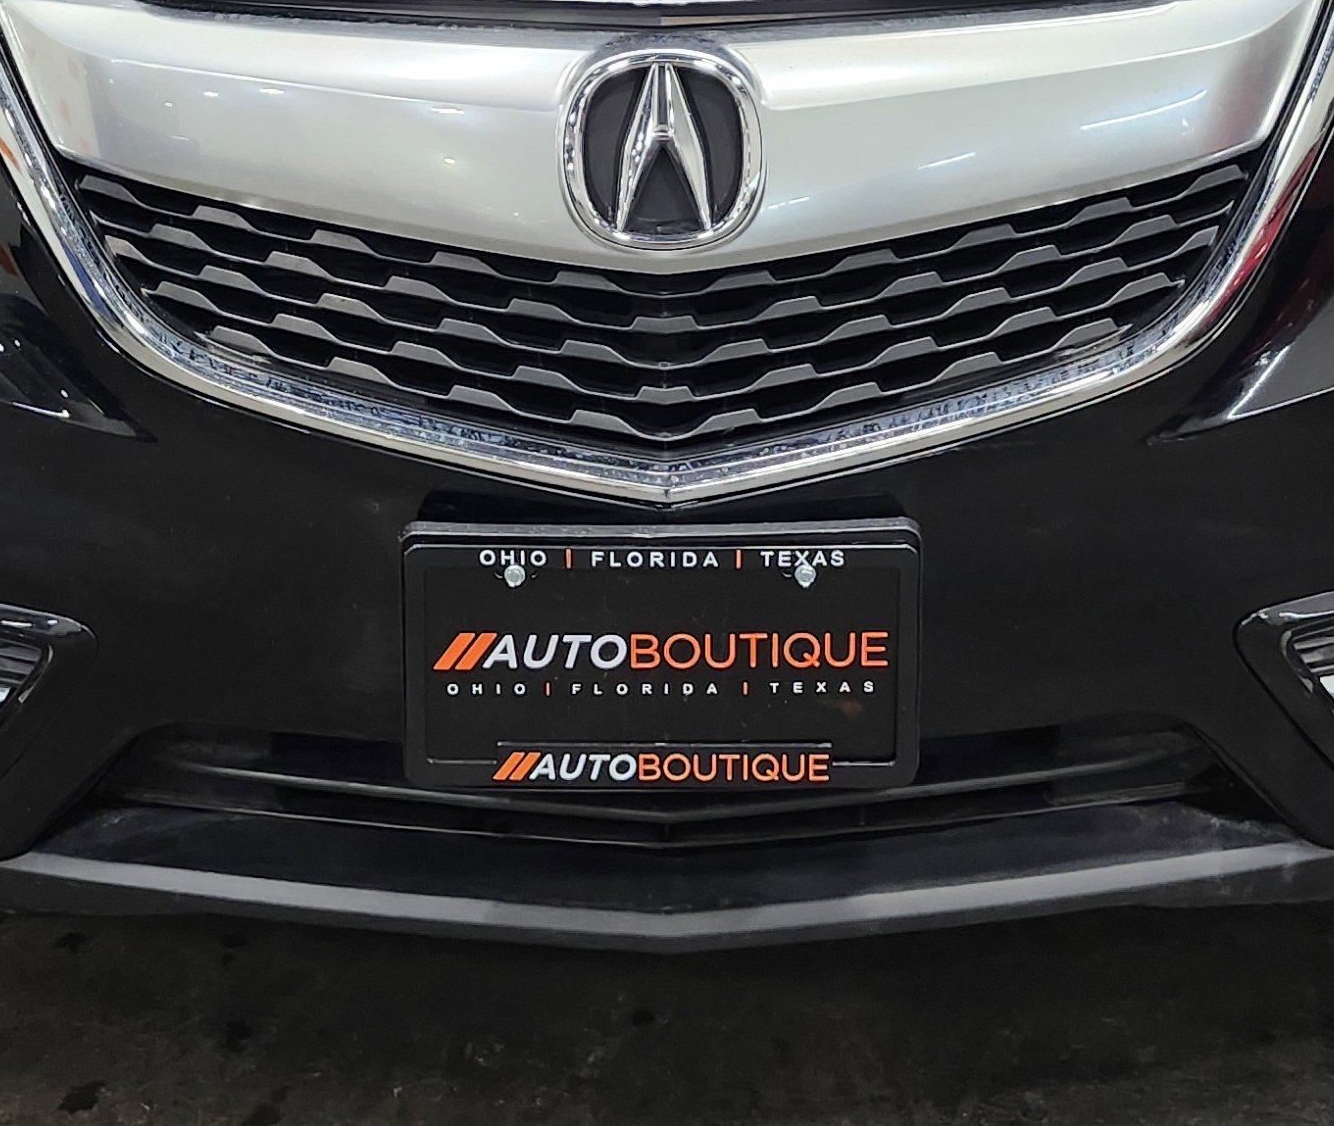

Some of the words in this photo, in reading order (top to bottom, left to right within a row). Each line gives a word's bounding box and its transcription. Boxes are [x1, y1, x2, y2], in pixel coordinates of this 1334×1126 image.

[479, 549, 548, 567] OHIO
[590, 550, 719, 568] FLORIDA
[760, 549, 845, 568] TEXAS
[482, 631, 889, 670] AUTOBOUTIQUE
[446, 682, 527, 695] OHIO
[571, 682, 718, 695] FLORIDA
[770, 680, 875, 694] TEXAS
[529, 752, 831, 782] AUTOBOUTIQUE
